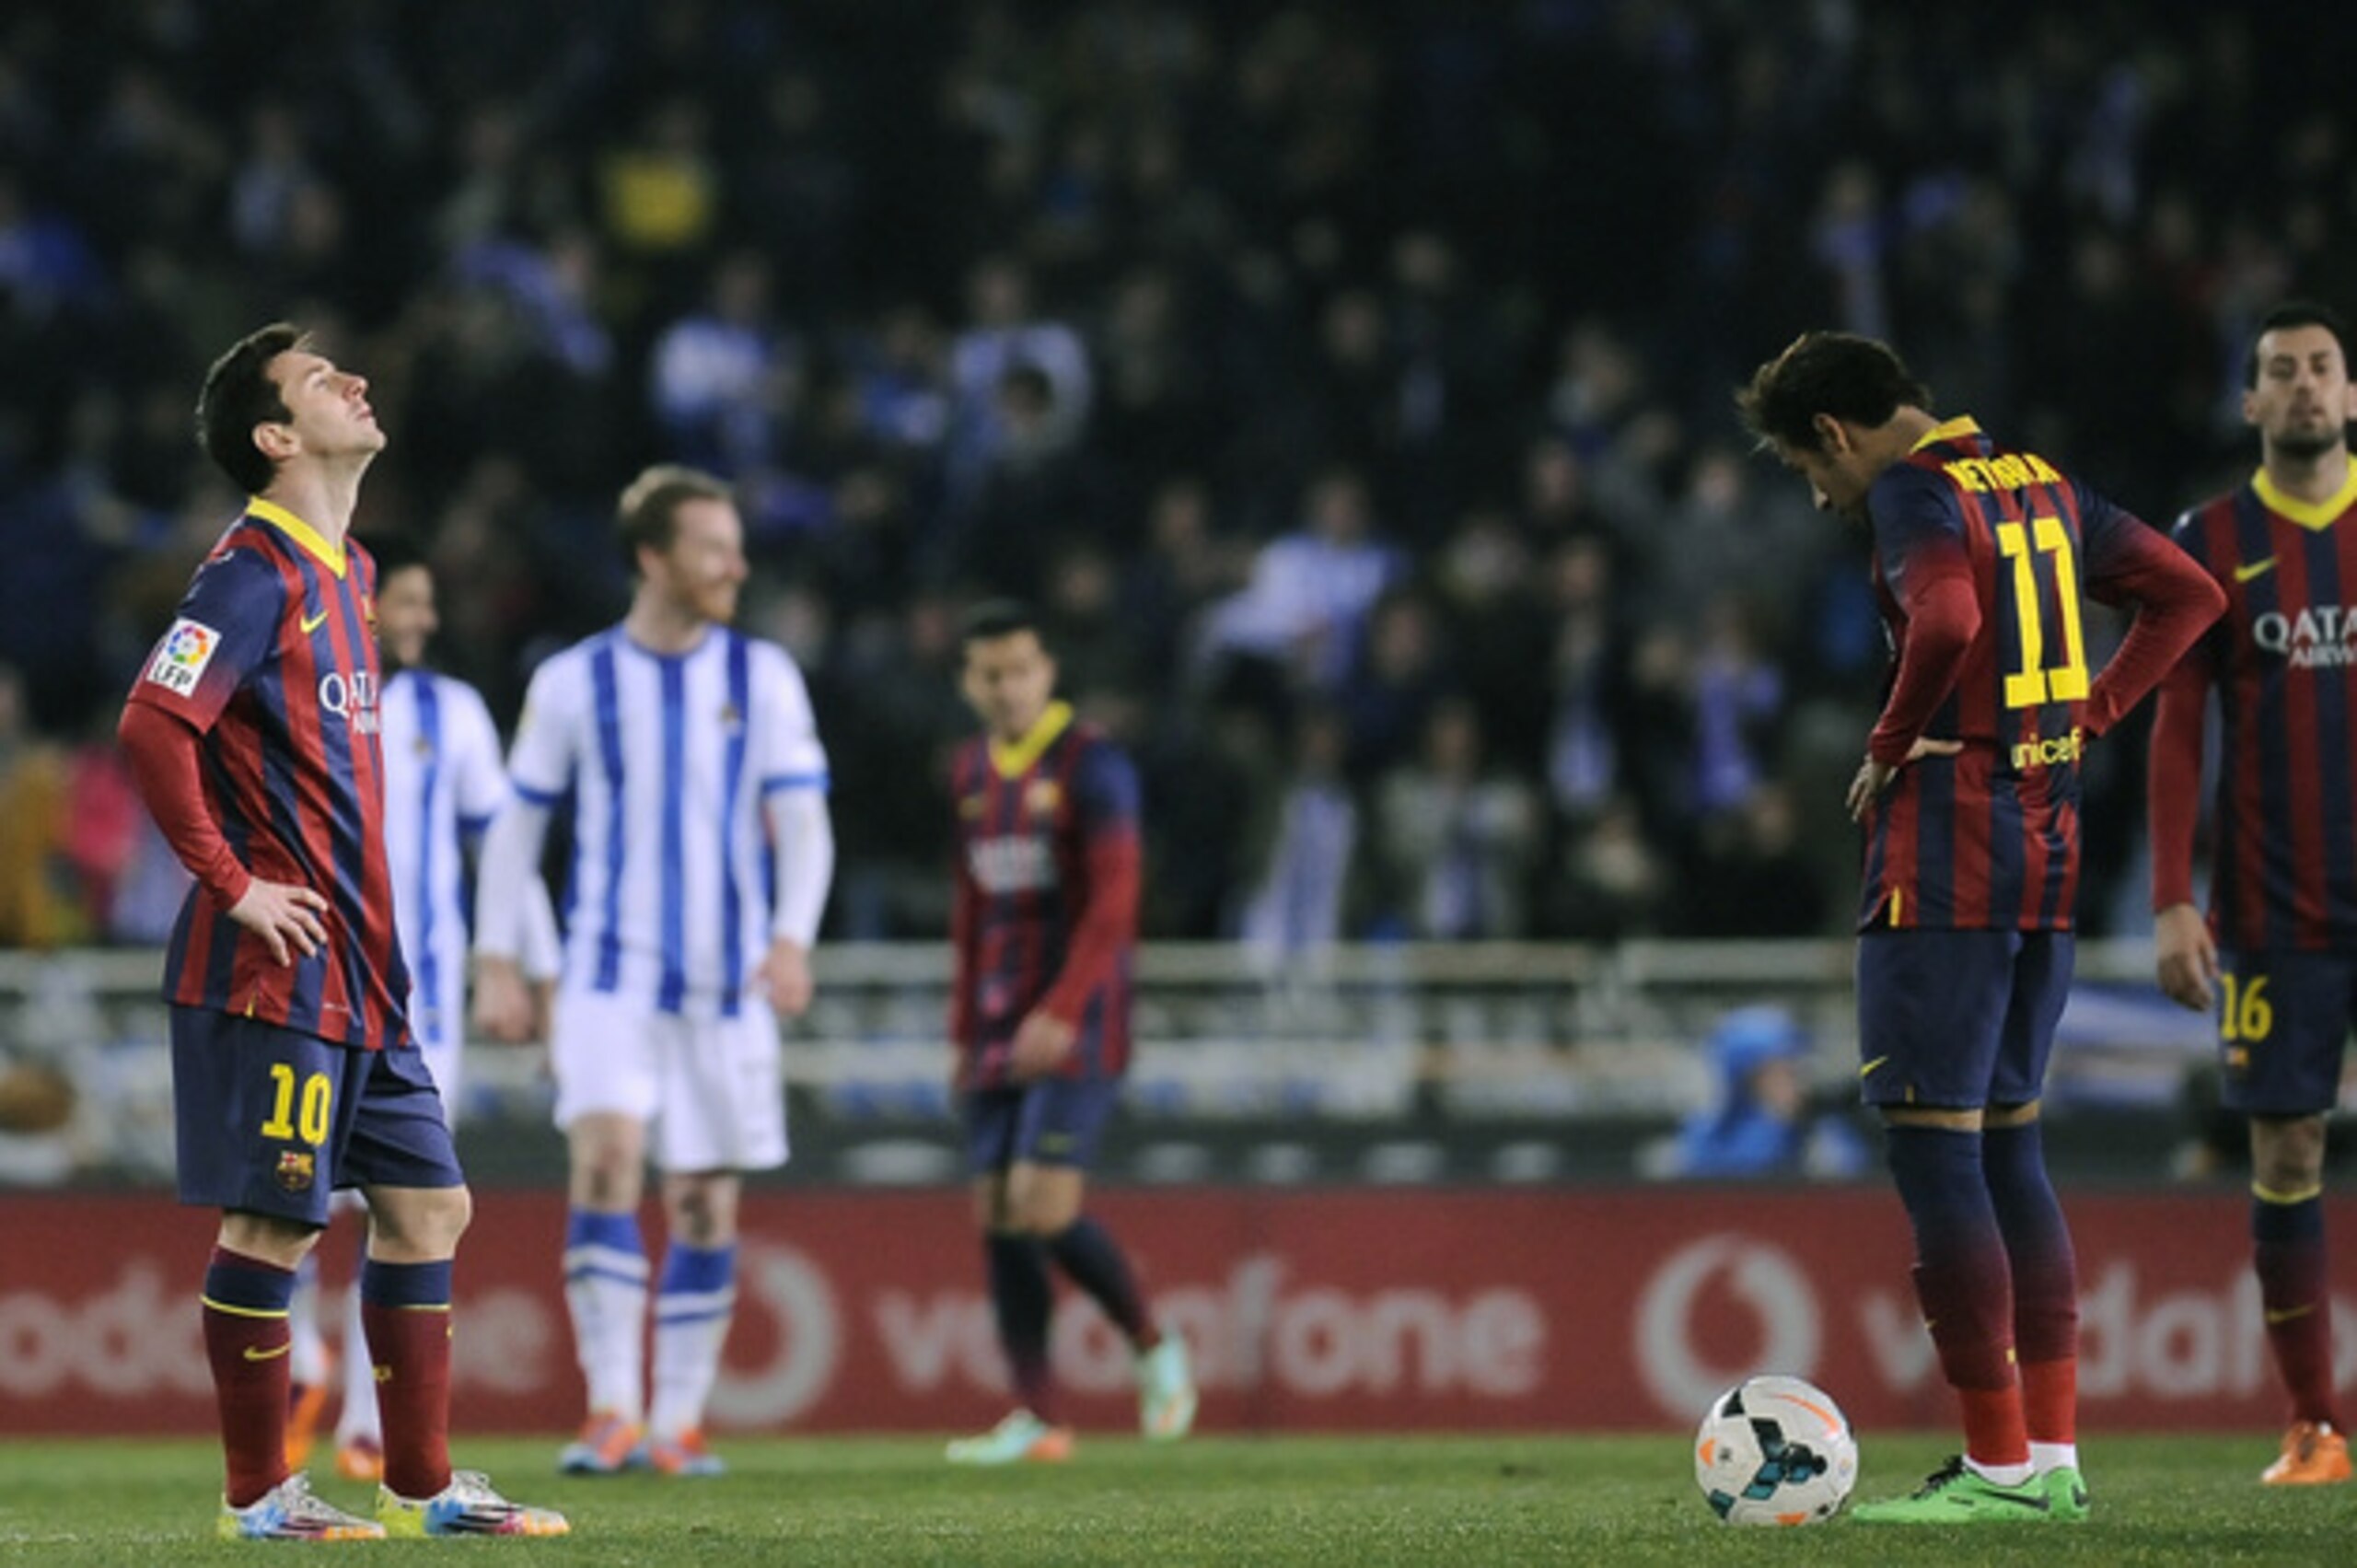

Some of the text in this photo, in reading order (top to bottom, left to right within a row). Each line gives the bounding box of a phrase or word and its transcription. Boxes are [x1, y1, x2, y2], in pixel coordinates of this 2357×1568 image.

[1996, 517, 2089, 708] 11
[153, 662, 192, 688] LFP
[2220, 972, 2273, 1042] 16
[261, 1063, 332, 1147] 10
